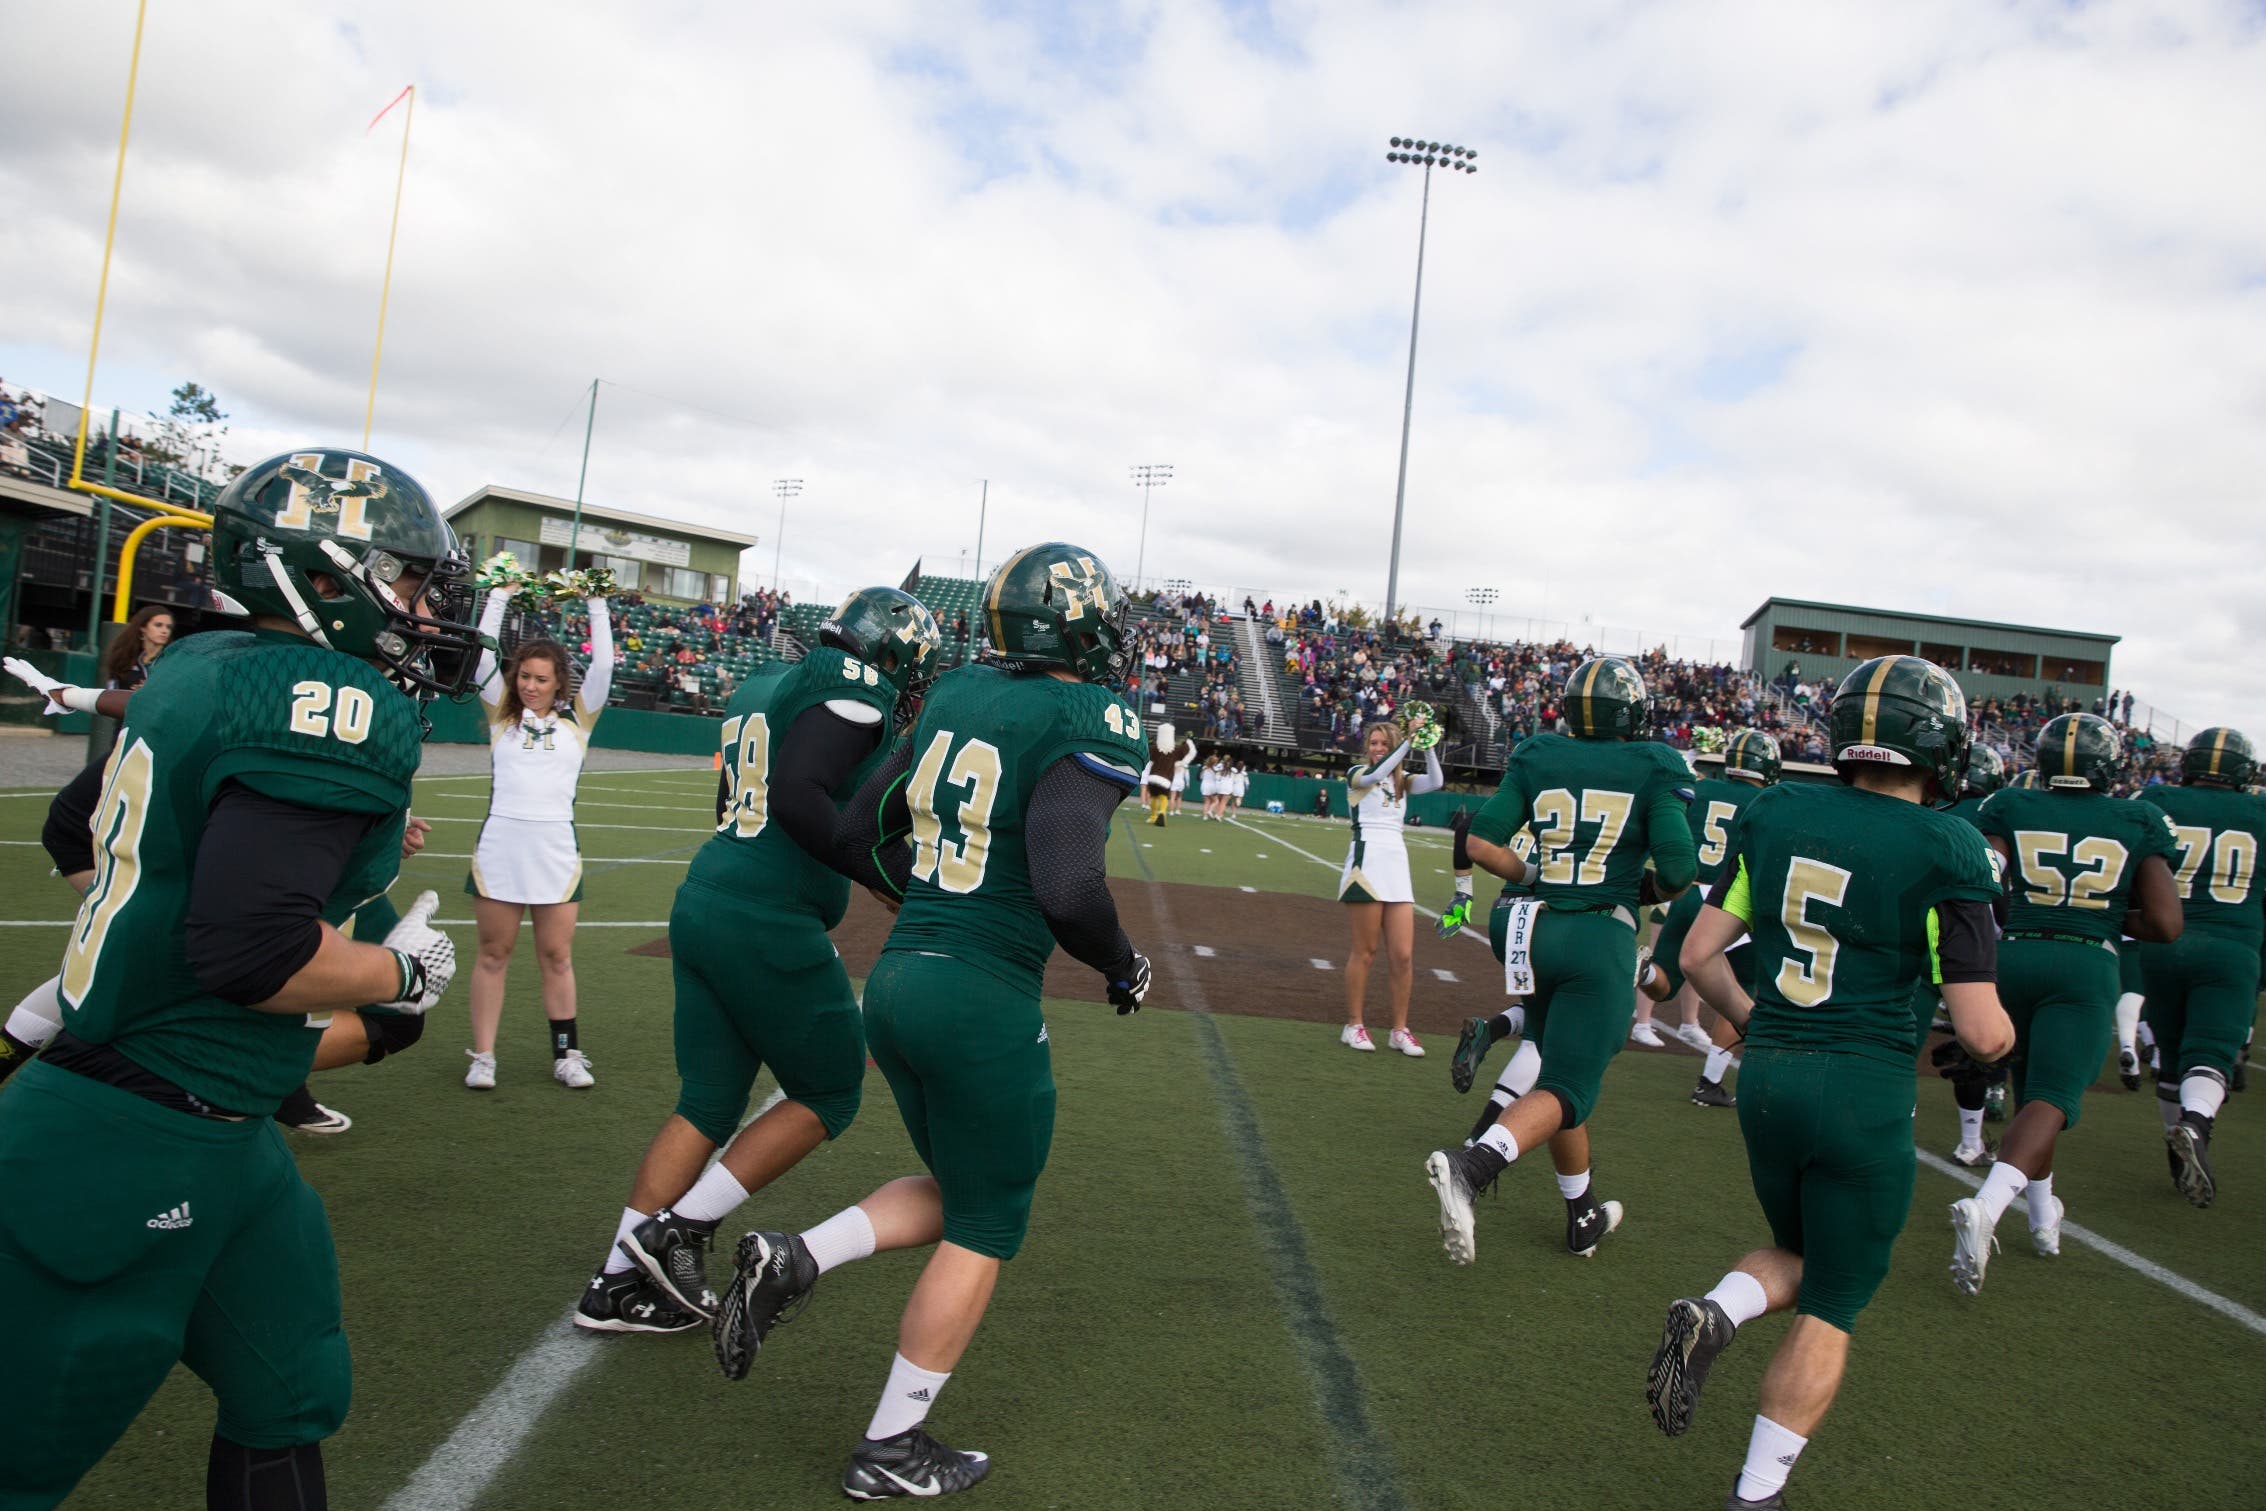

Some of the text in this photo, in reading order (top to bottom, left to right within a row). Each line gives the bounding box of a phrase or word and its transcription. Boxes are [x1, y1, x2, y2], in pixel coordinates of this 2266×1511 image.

[290, 681, 374, 745] 20
[1104, 703, 1140, 740] 43
[716, 712, 771, 837] 58
[906, 729, 1003, 894] 43
[1533, 788, 1635, 884] 27
[1698, 801, 1738, 866] 5
[2014, 830, 2129, 909] 52
[2173, 826, 2258, 905] 70
[1510, 951, 1527, 965] 27
[1775, 856, 1852, 1008] 5
